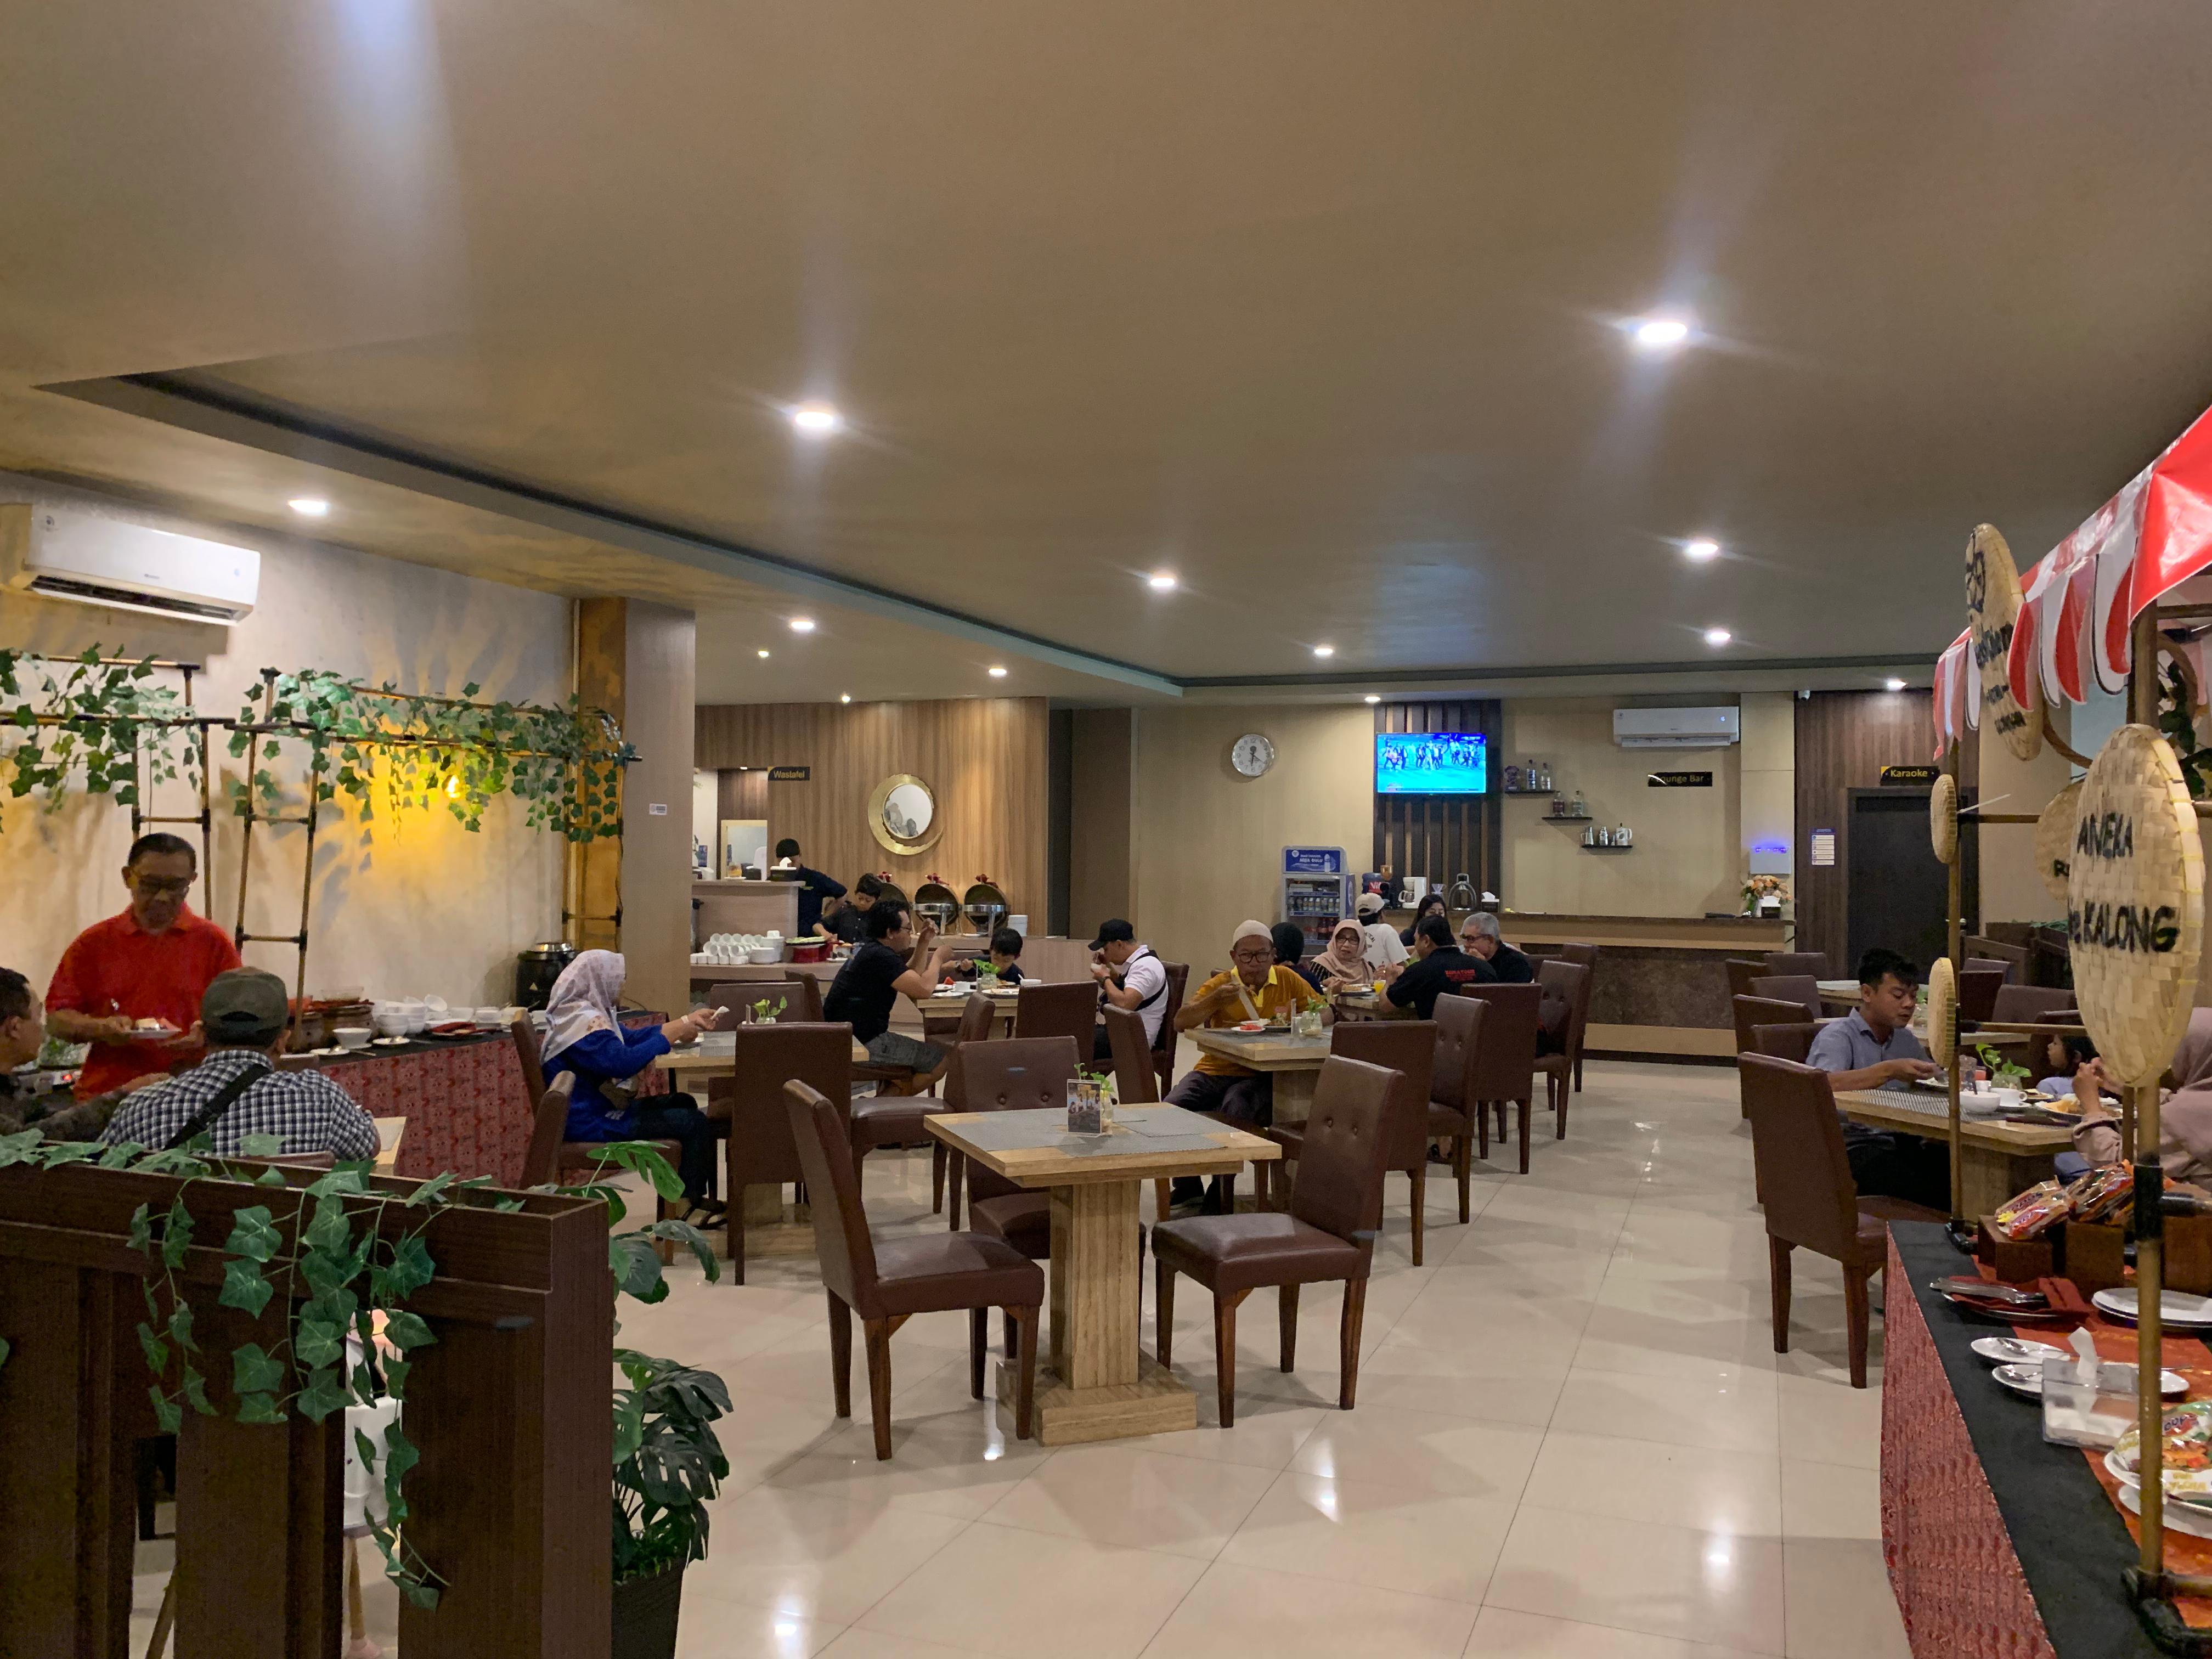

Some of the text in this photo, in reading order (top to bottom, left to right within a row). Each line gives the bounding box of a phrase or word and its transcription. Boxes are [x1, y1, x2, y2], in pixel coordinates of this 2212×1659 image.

[774, 770, 805, 778] Wastafel
[1891, 769, 1928, 777] Karaoke
[2076, 812, 2134, 858] ANEKA
